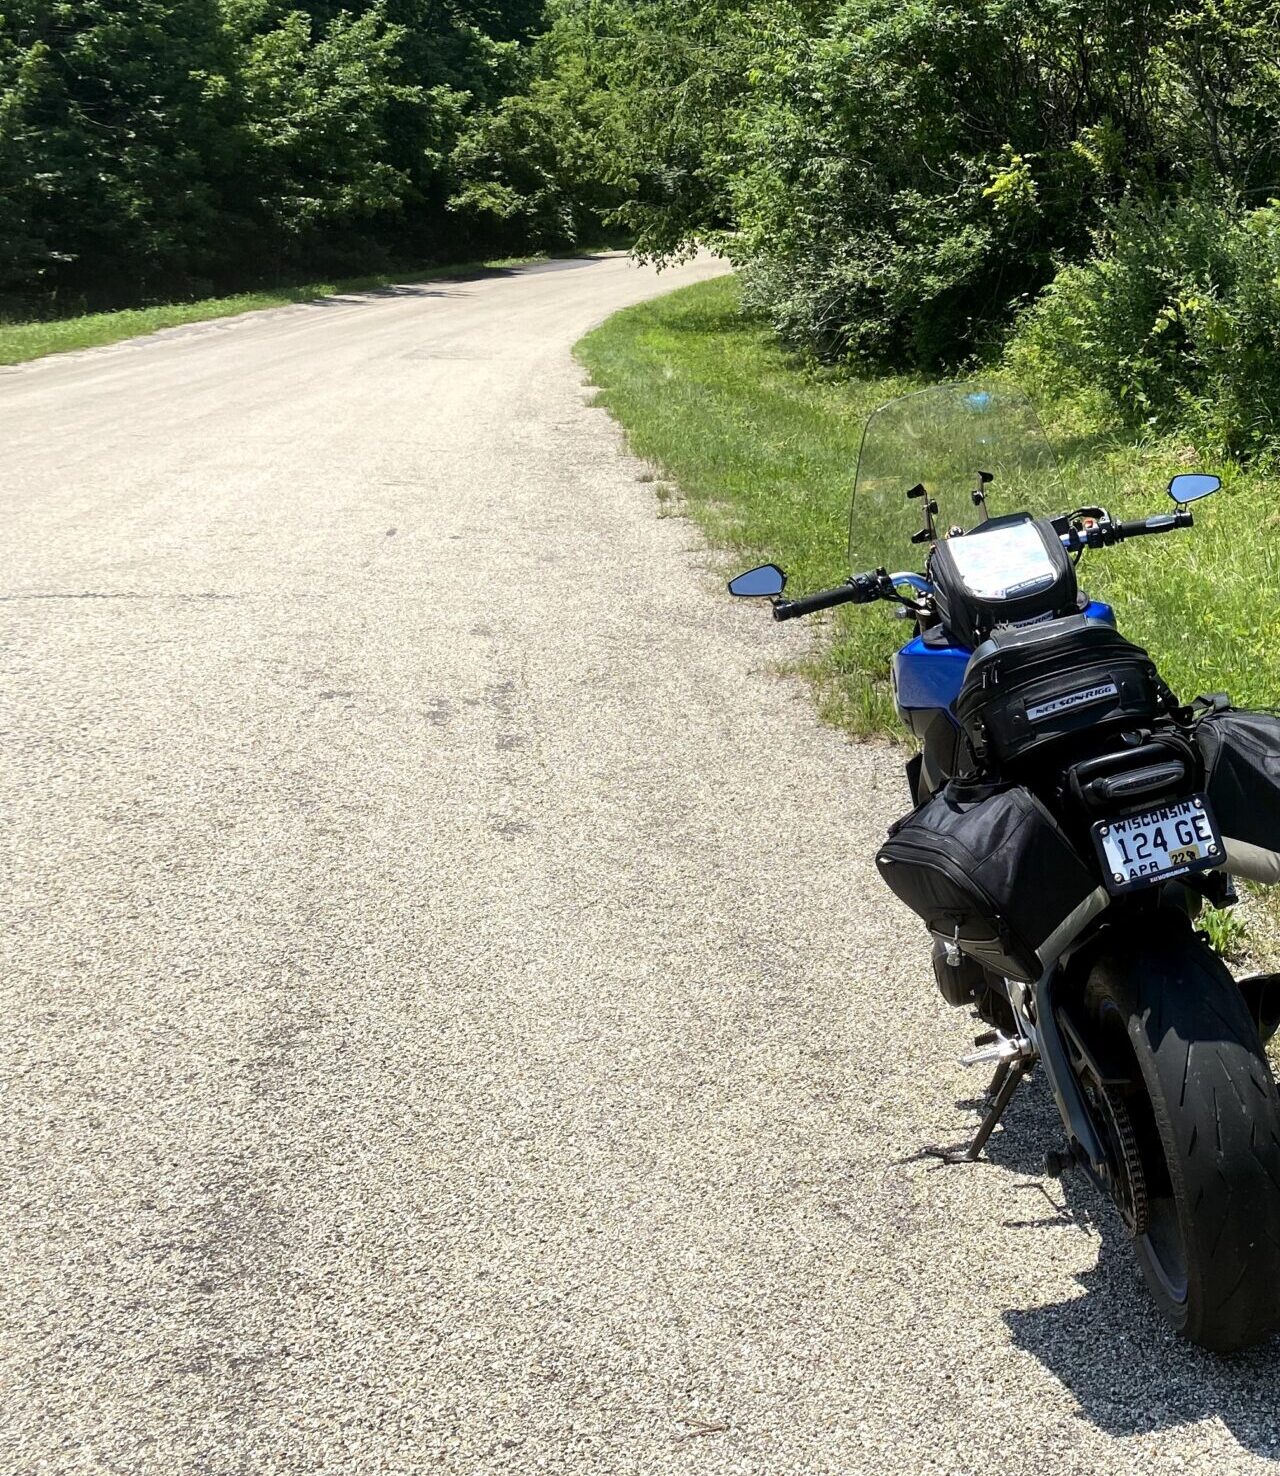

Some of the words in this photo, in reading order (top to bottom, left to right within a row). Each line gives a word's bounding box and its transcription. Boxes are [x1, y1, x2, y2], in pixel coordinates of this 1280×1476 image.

[1112, 802, 1192, 834] WISCONSIN
[1118, 826, 1169, 865] 124
[1174, 814, 1212, 846] GE
[1129, 860, 1160, 879] APR
[1171, 852, 1186, 865] 22
